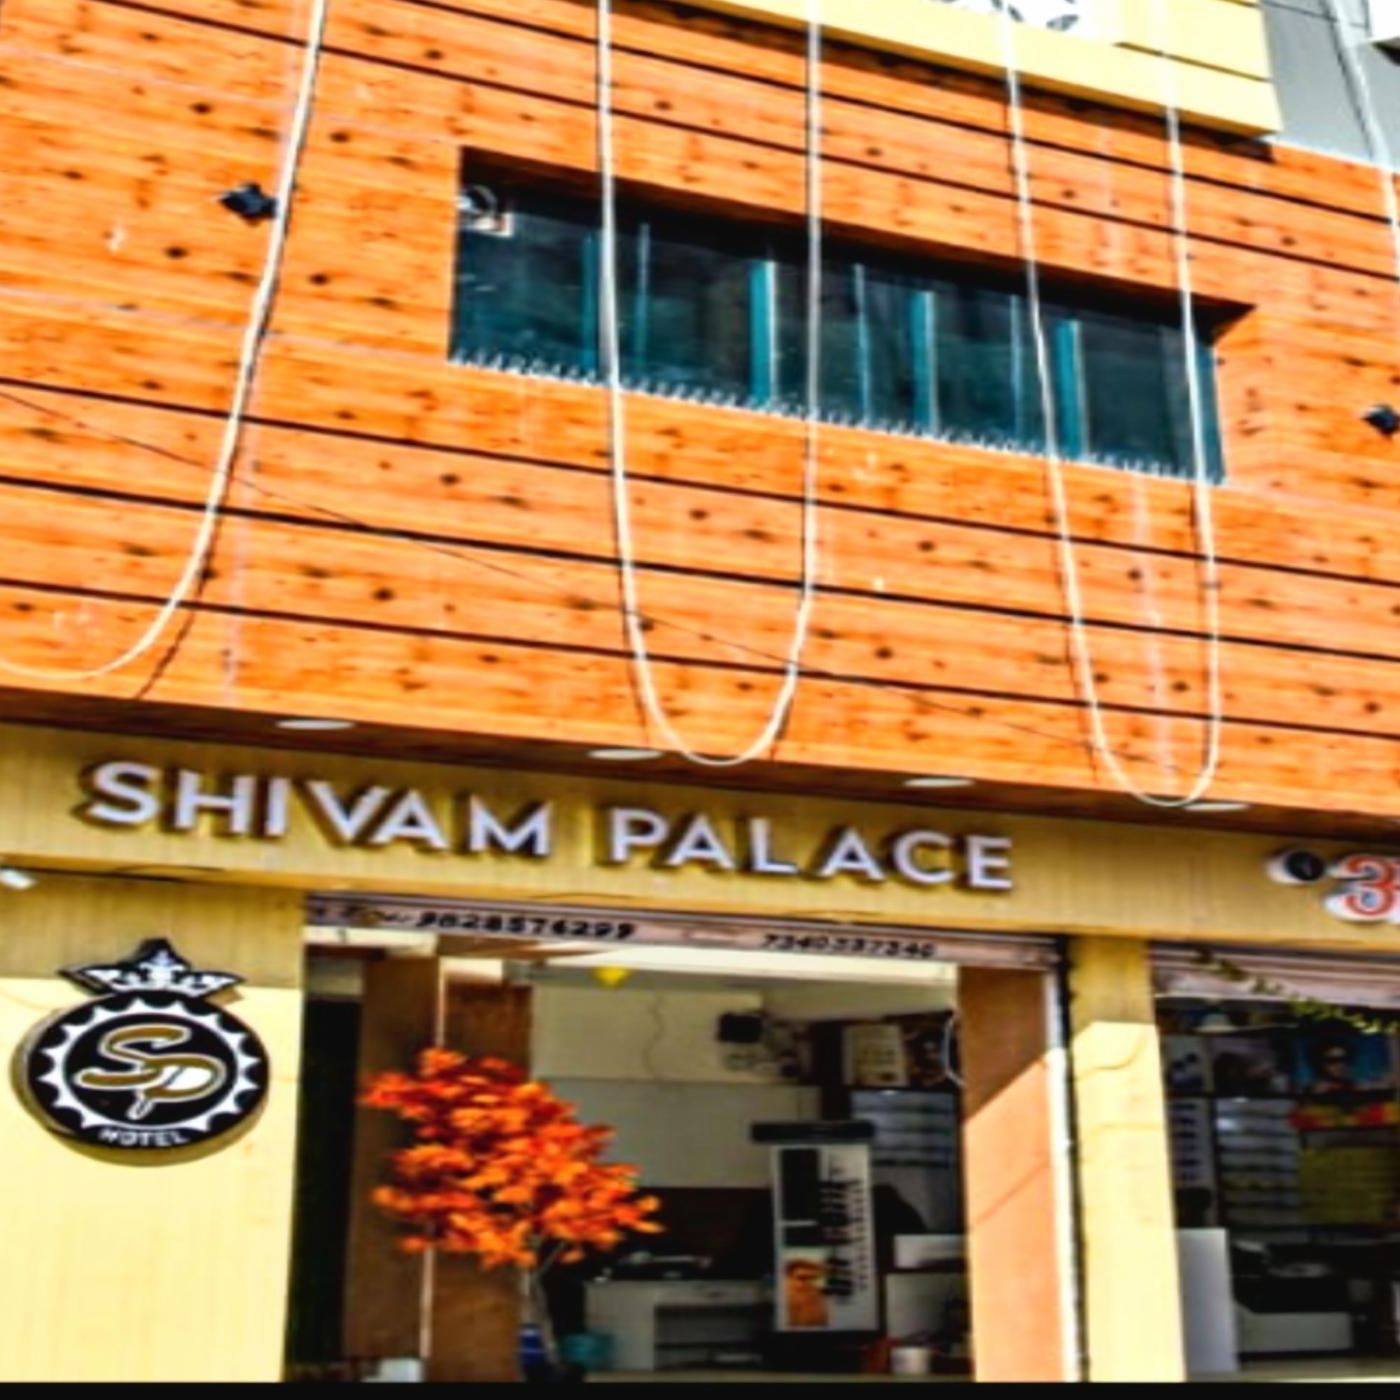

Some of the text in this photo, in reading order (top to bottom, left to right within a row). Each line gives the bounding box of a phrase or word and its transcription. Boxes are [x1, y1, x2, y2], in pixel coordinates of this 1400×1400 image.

[86, 760, 1014, 892] SHIVAM PALACE
[99, 1127, 191, 1148] HOTEL
